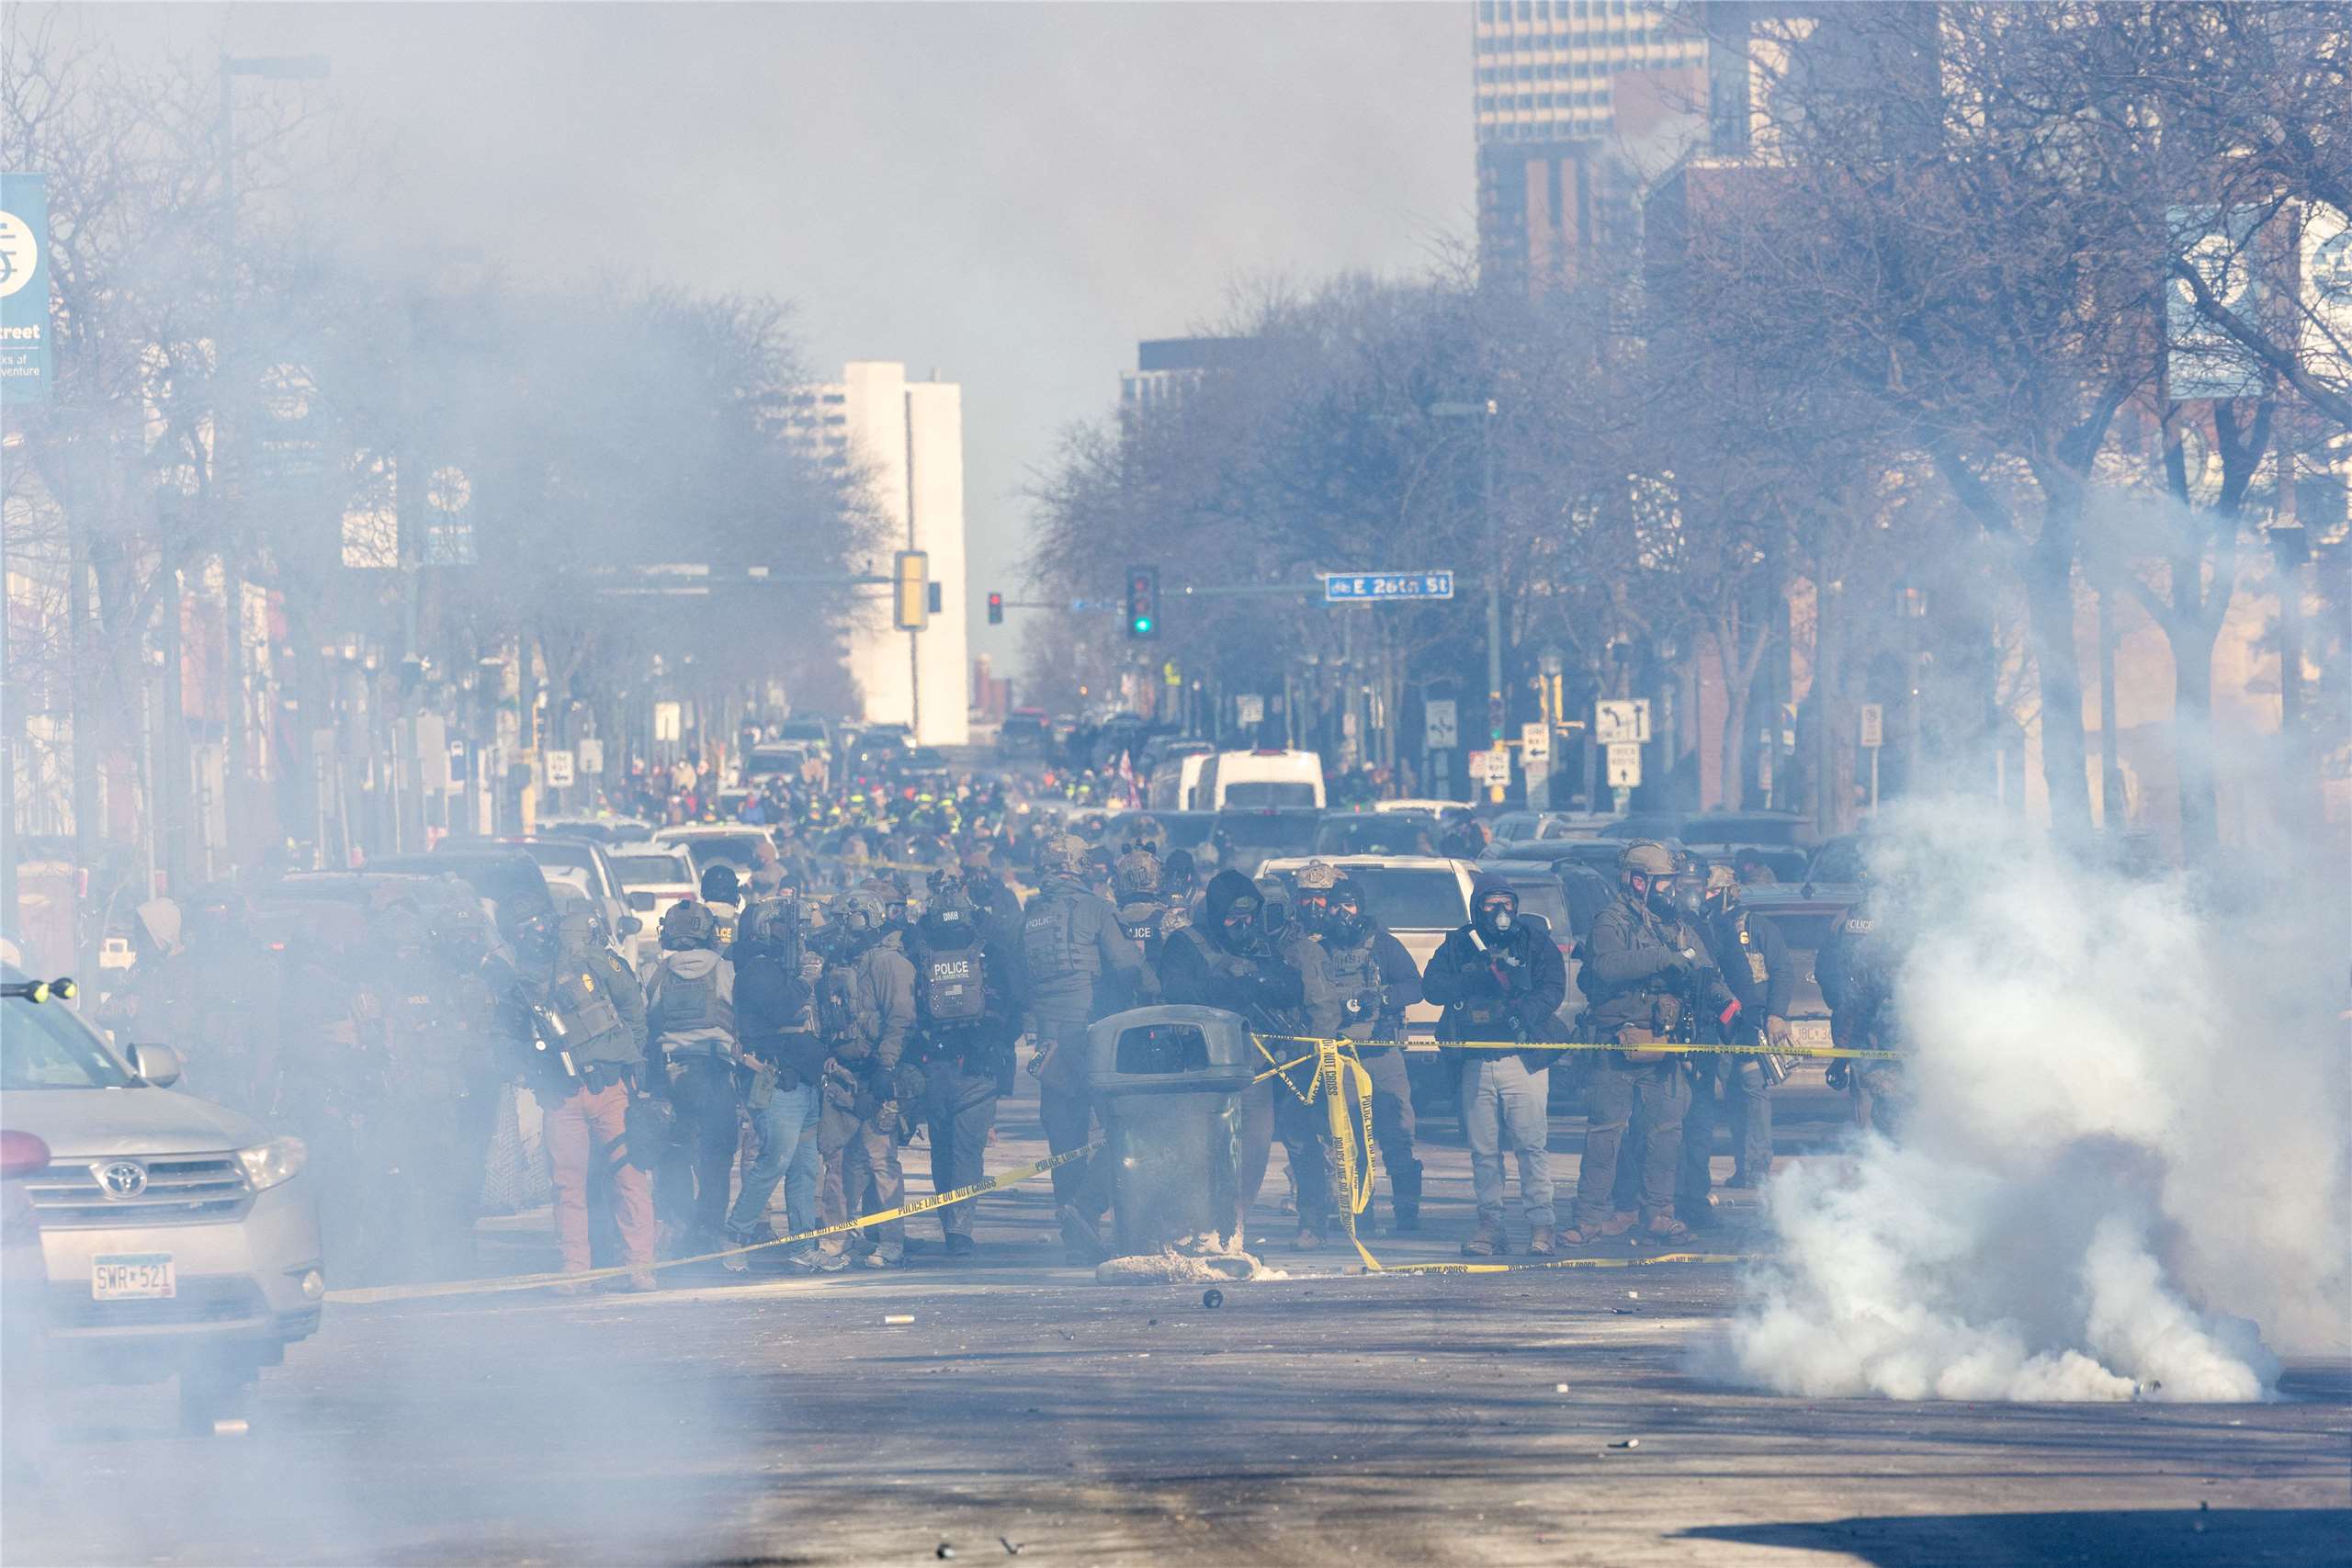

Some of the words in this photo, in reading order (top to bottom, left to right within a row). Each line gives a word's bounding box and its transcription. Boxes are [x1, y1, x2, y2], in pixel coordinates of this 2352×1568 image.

[1353, 579, 1366, 594] E
[1373, 578, 1419, 594] 26th
[1426, 577, 1448, 593] St
[934, 961, 969, 976] POLICE
[1324, 1052, 1337, 1067] NOT
[1325, 1070, 1339, 1096] CROSS
[1361, 1095, 1373, 1122] POLICE
[1035, 1154, 1060, 1170] POLICE
[898, 1200, 925, 1215] POLICE
[925, 1194, 942, 1209] LINE
[943, 1191, 954, 1203] DO
[956, 1186, 971, 1200] NOT
[971, 1176, 998, 1194] CROSS
[96, 1266, 128, 1290] SWR
[140, 1264, 170, 1288] 521
